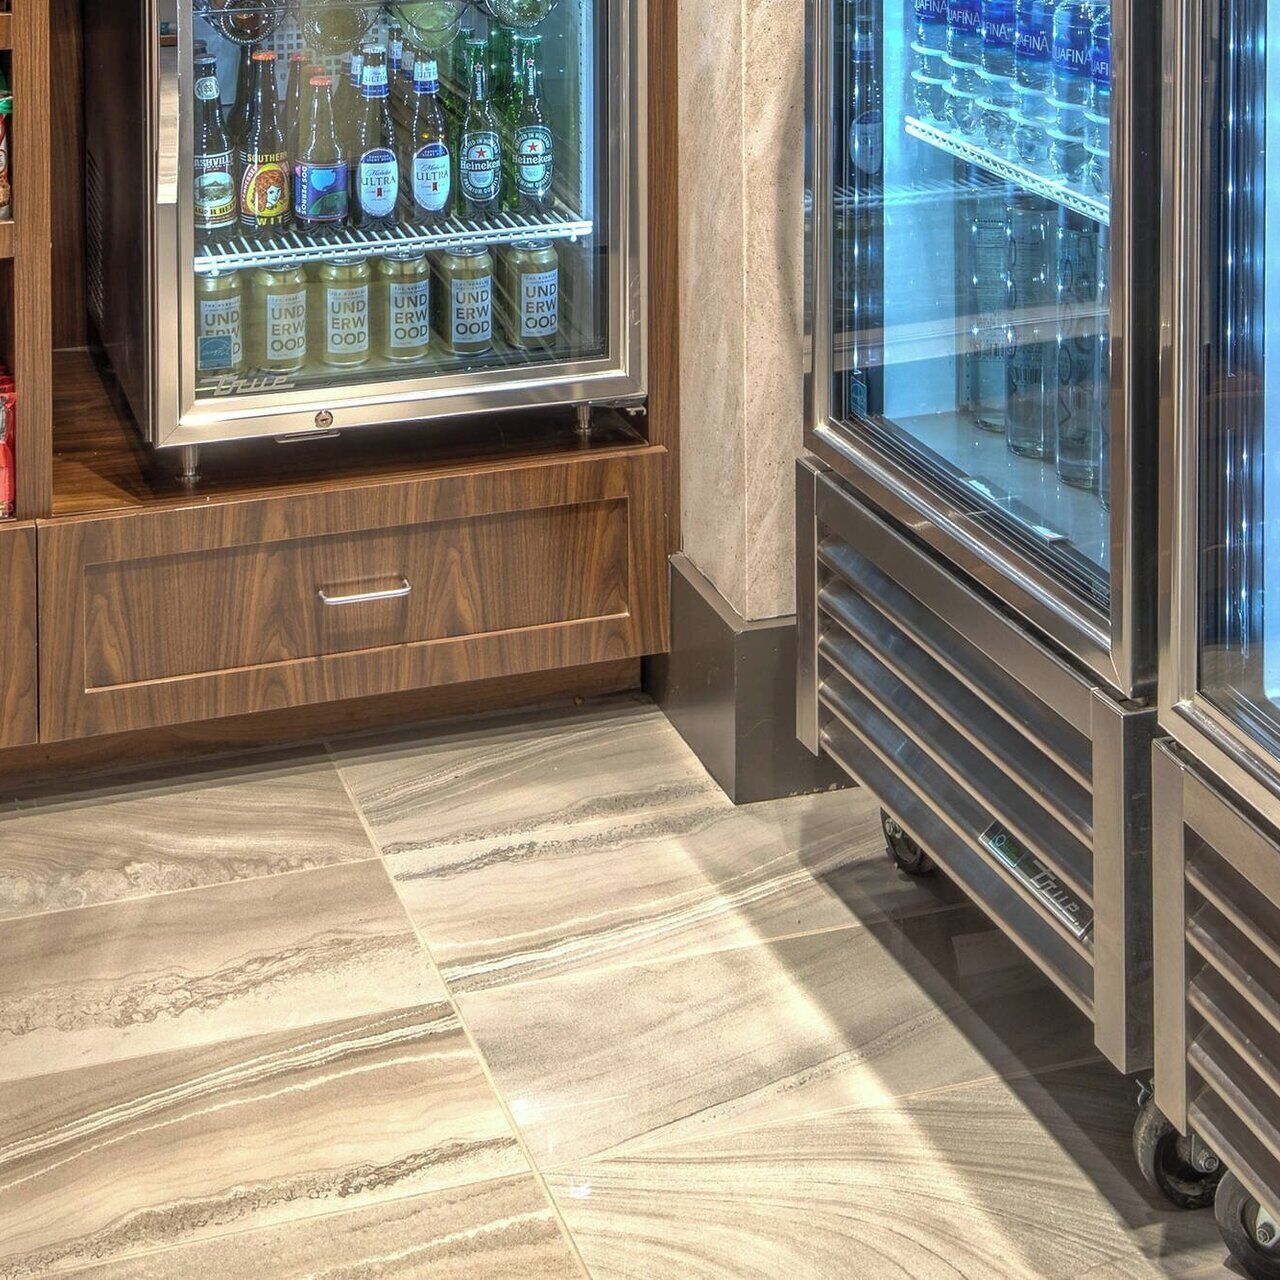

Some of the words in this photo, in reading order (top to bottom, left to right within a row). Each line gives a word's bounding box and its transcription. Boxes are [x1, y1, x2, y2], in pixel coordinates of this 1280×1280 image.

[947, 9, 980, 26] UAFINA
[1054, 45, 1092, 65] UAFINA
[460, 160, 501, 171] Heineken
[513, 154, 553, 166] Heineken
[361, 175, 396, 186] ULTRA
[416, 170, 449, 181] ULTRA
[456, 290, 489, 304] UND
[526, 283, 557, 298] UND
[331, 300, 366, 313] UND
[395, 294, 427, 309] UND
[526, 297, 557, 313] ERW
[205, 311, 240, 326] UND
[271, 305, 305, 320] UND
[395, 308, 427, 324] ERW
[456, 304, 489, 320] ERW
[271, 320, 305, 337] ERW
[331, 315, 366, 330] ERW
[456, 321, 489, 335] OOD
[526, 314, 557, 329] OOD
[331, 331, 366, 346] OOD
[395, 325, 427, 340] OOD
[271, 336, 305, 352] OOD
